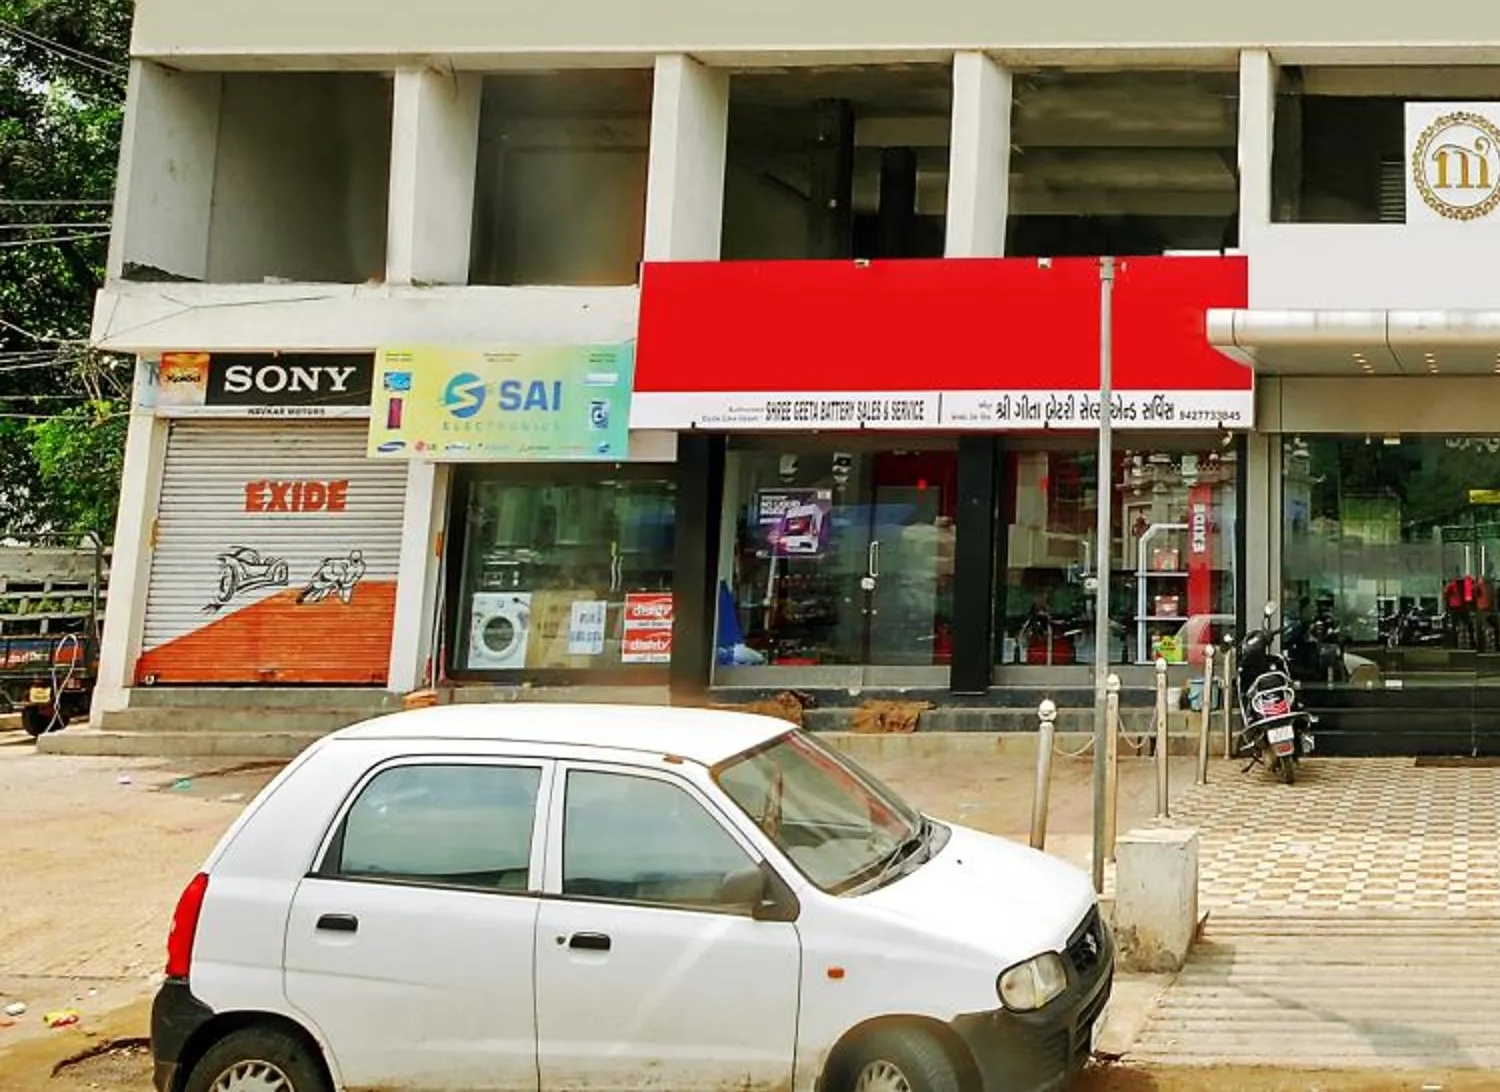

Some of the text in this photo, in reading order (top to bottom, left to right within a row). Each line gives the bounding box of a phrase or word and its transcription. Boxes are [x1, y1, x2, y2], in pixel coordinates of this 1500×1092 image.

[224, 365, 356, 393] SONY
[498, 380, 562, 411] SAI
[820, 401, 855, 420] BATTERY
[857, 401, 881, 420] SALES
[245, 479, 349, 513] EXIDE
